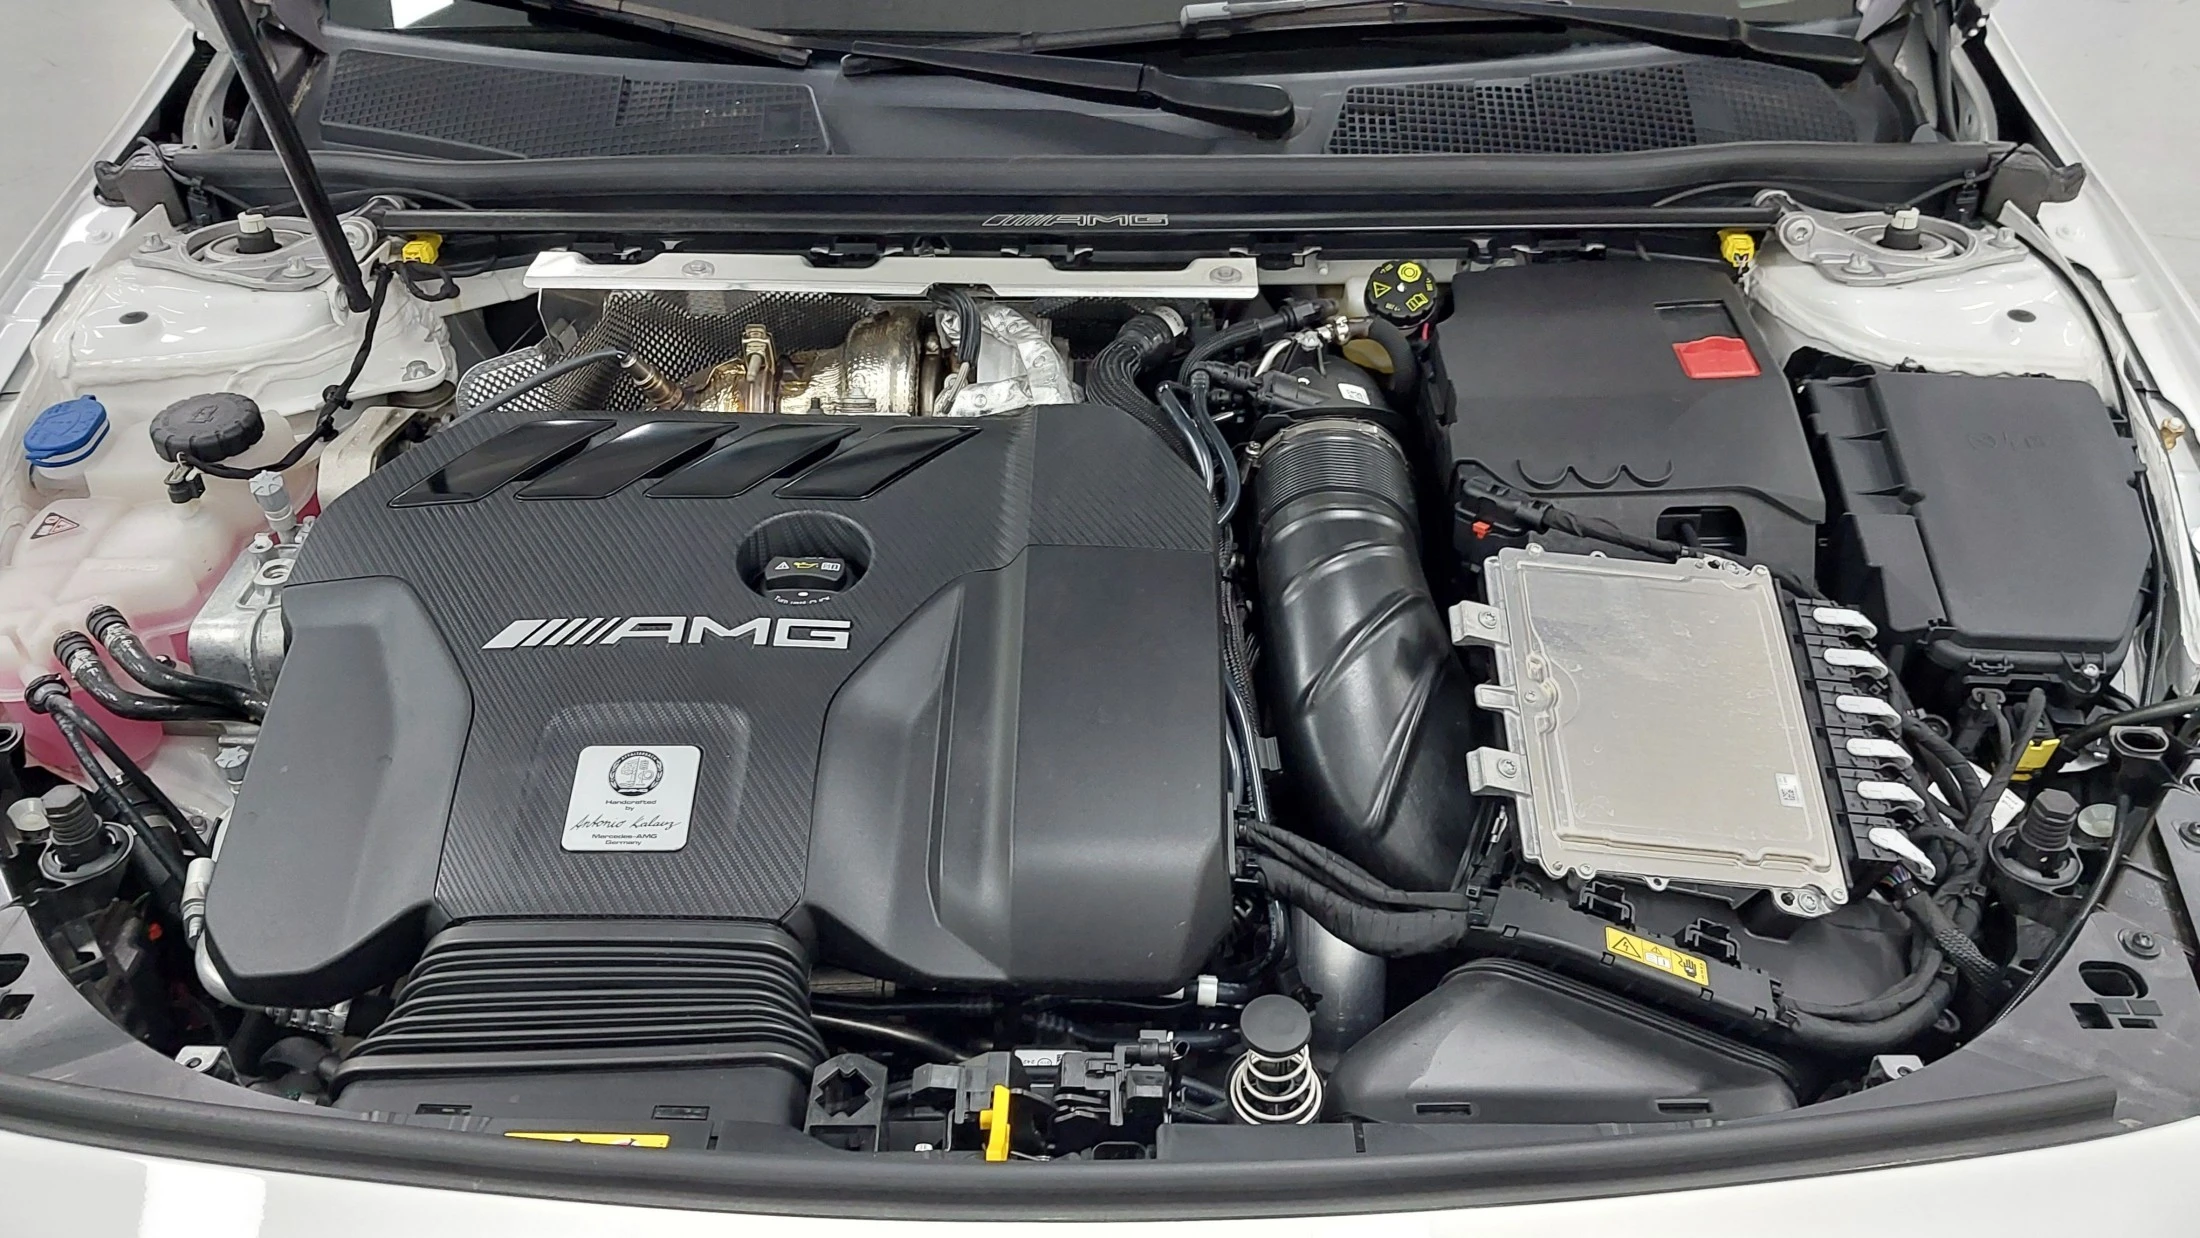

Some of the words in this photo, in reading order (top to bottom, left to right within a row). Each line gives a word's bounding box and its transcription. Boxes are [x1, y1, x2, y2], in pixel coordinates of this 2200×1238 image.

[1043, 213, 1170, 227] AMG
[598, 616, 852, 650] AMG
[570, 813, 627, 830] Antonio
